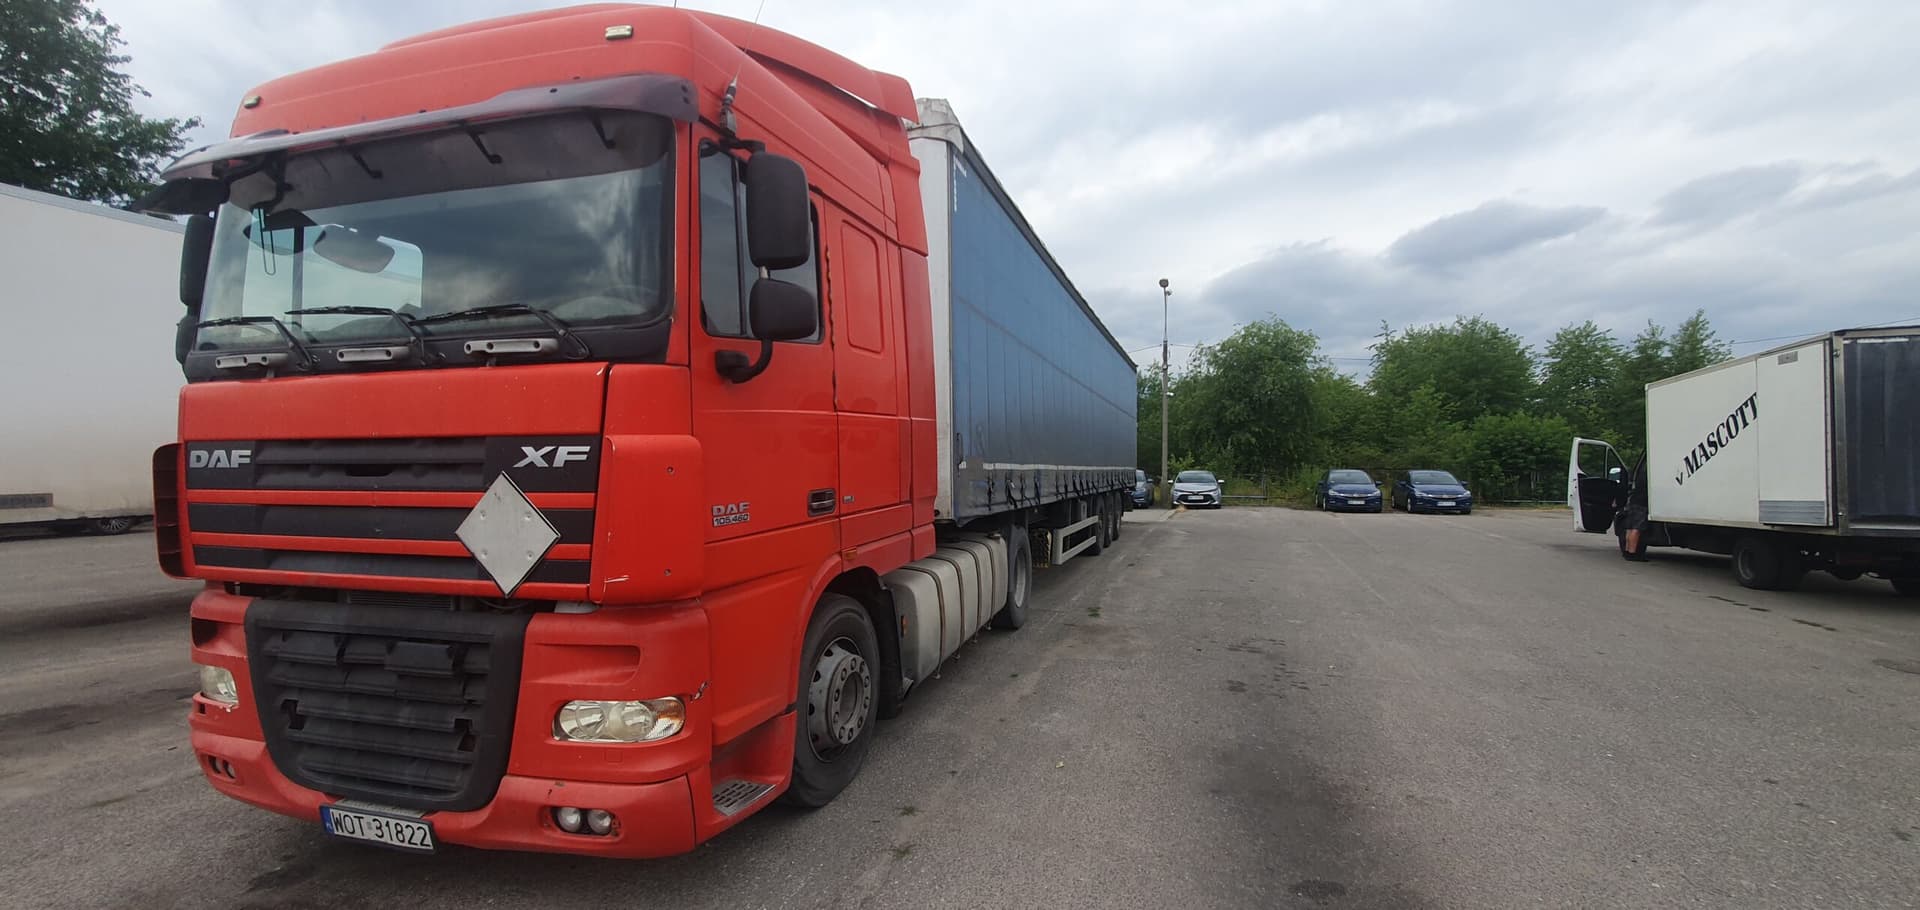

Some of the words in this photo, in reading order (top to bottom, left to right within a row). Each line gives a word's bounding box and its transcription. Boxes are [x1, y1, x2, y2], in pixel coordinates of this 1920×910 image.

[1683, 391, 1758, 478] MASCOTT
[189, 449, 252, 468] DAF
[512, 445, 591, 468] XF
[712, 501, 750, 516] DAF
[331, 811, 365, 837] WOT
[372, 818, 431, 847] 31822
